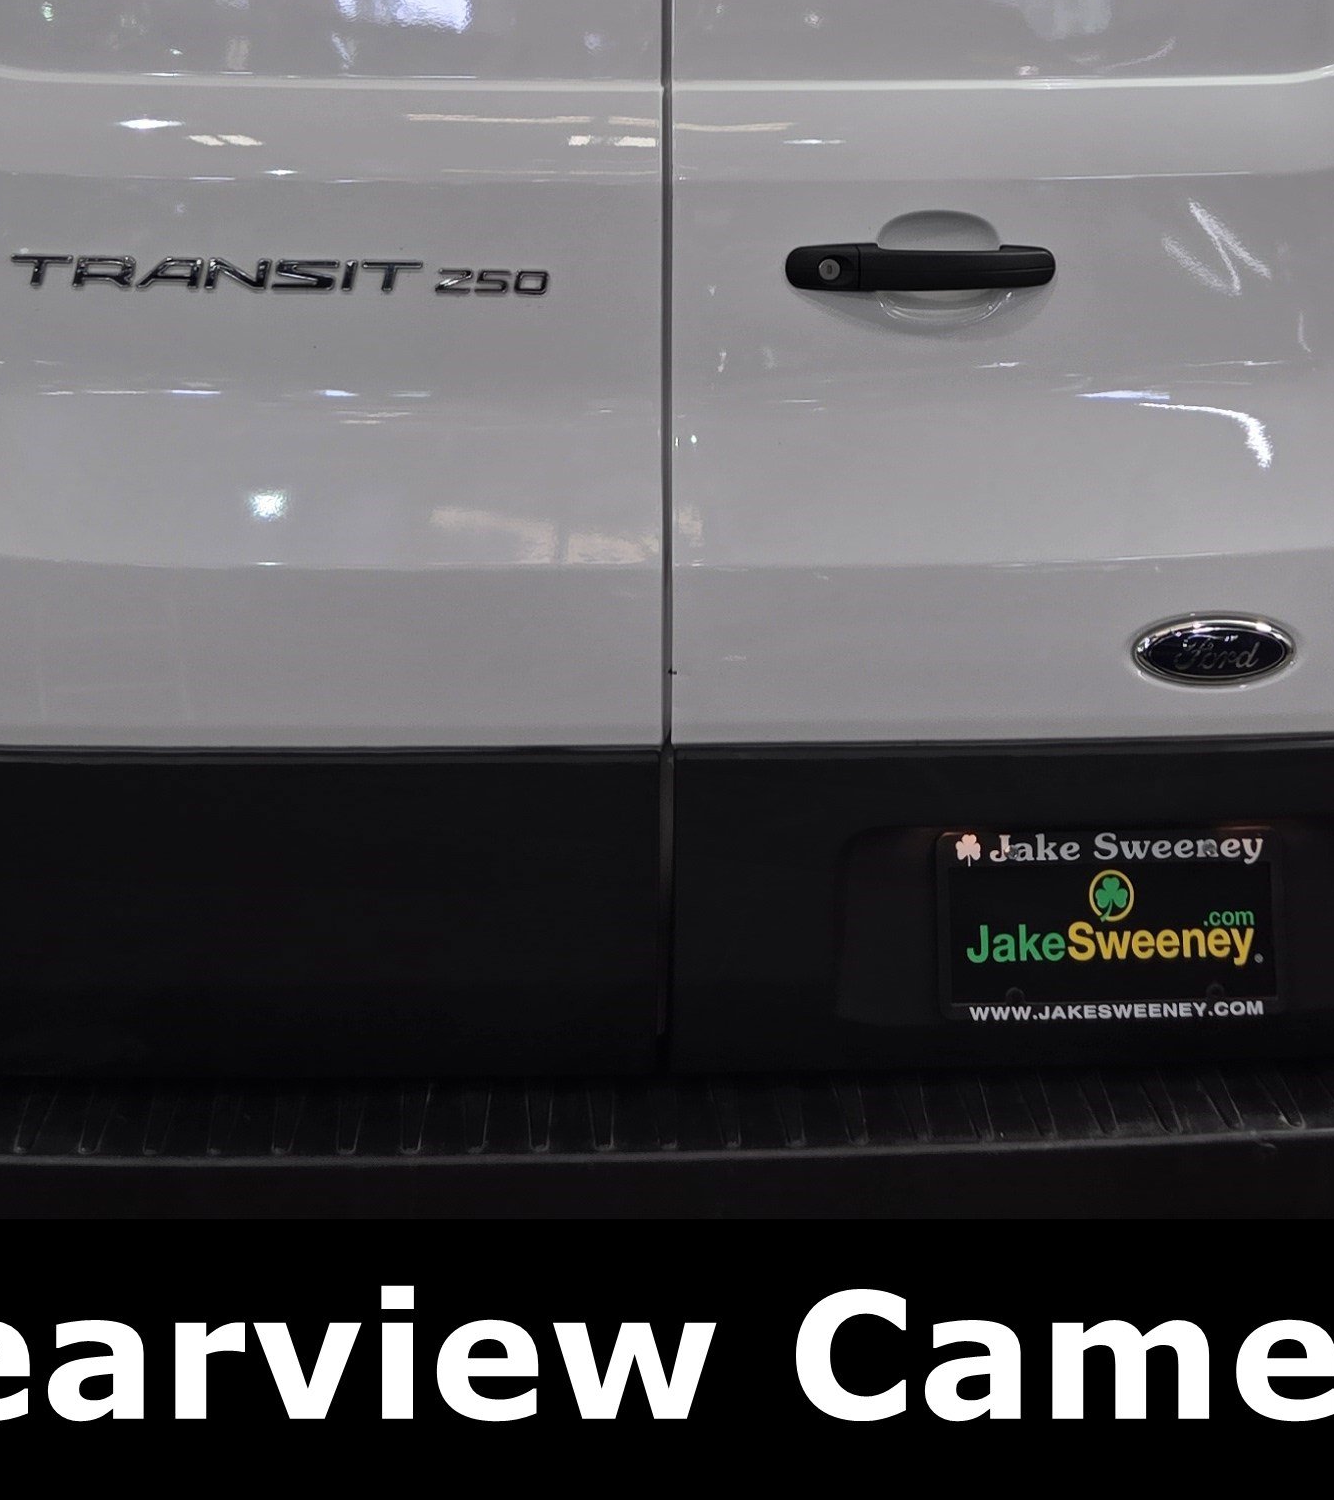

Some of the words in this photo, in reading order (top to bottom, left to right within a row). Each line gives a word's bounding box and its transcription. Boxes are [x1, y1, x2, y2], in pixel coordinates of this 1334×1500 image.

[11, 255, 424, 293] TRANSIT
[434, 268, 551, 296] 250
[1173, 637, 1260, 670] Ford
[989, 833, 1081, 863] Jake
[1093, 832, 1264, 865] Sweeney
[969, 1000, 1265, 1022] WWW.JAKESWEENEY.COM
